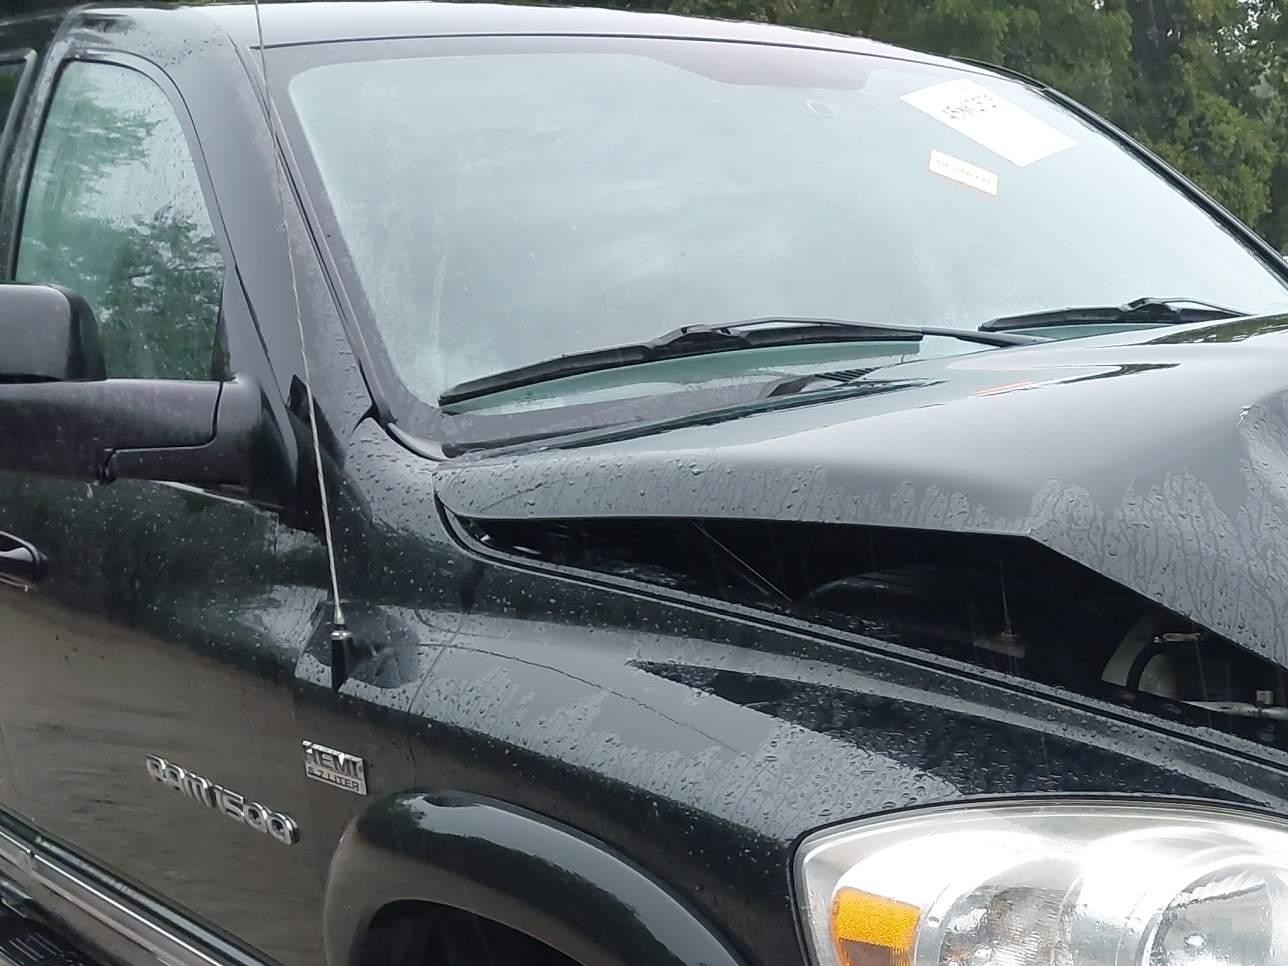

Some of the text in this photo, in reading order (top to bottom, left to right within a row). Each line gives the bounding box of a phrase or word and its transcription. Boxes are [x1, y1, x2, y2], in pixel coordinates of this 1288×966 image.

[303, 740, 364, 778] HEMI
[146, 753, 300, 845] RAM 1500
[325, 771, 360, 793] LITER
